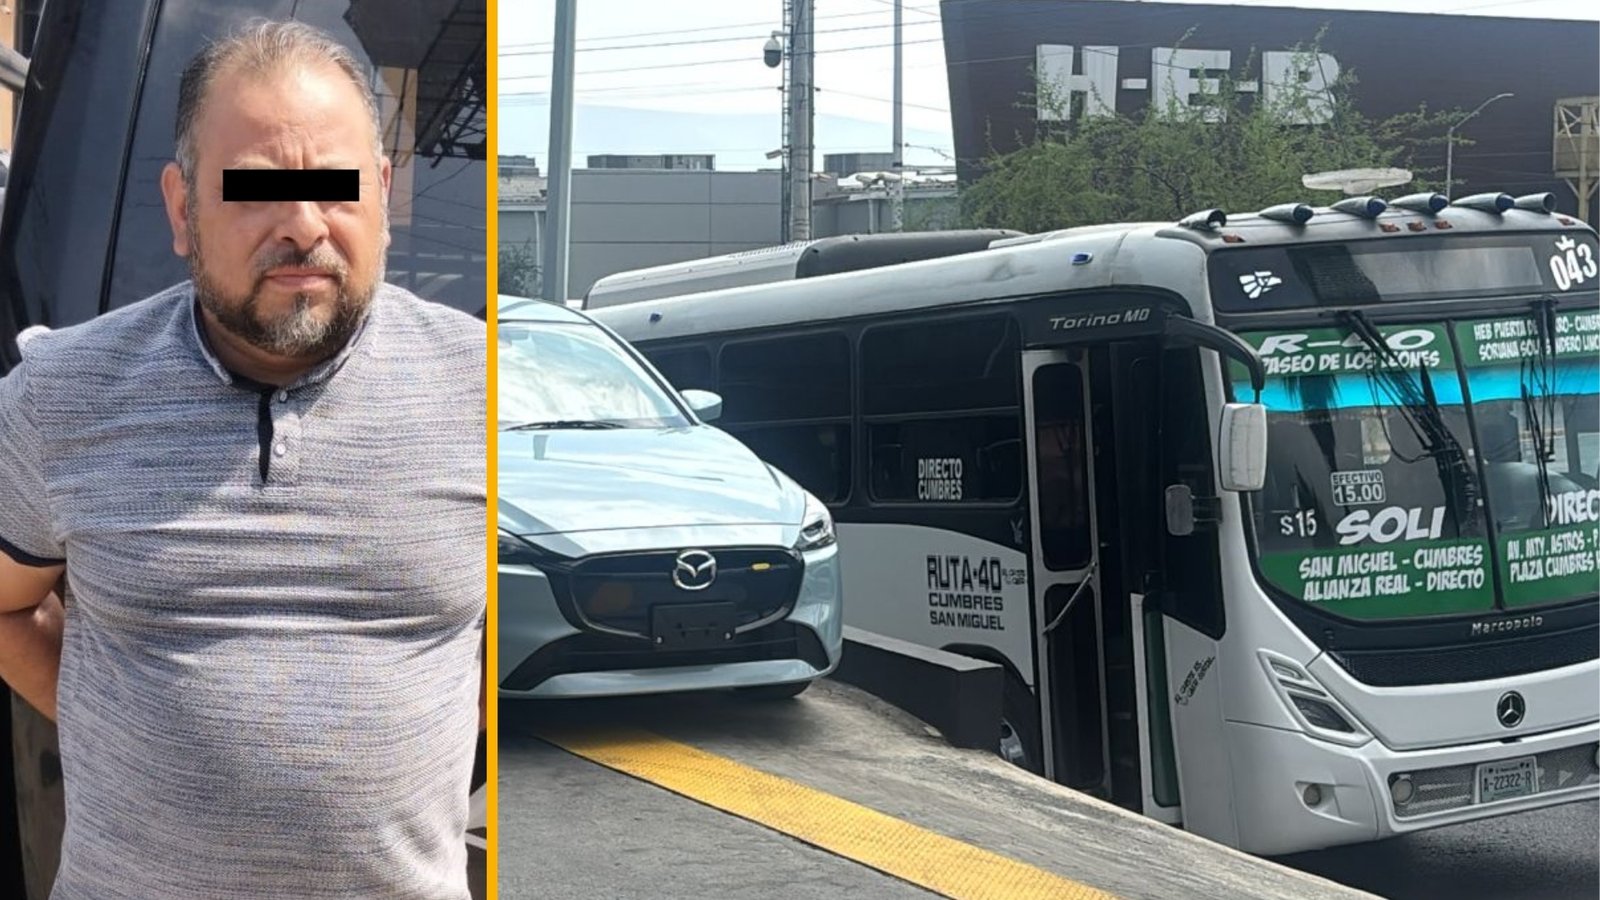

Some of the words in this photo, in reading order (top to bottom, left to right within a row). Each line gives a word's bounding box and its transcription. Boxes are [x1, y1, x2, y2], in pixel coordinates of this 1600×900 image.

[1036, 44, 1340, 125] H-E-B
[1549, 243, 1597, 291] 043
[1049, 313, 1121, 330] Torino
[1474, 323, 1492, 341] HEB
[1494, 320, 1526, 339] PUERTA
[1479, 341, 1520, 361] SORIANA
[1262, 354, 1315, 375] PASEO
[1319, 354, 1340, 370] DE
[1344, 352, 1377, 370] LOS
[918, 458, 963, 479] DIRECTO
[1332, 473, 1383, 485] EFECTIVO
[918, 480, 963, 500] CUMBRES
[1334, 484, 1383, 503] 15.00
[1335, 506, 1446, 545] SOLI
[1551, 530, 1585, 555] ASTROS
[1299, 556, 1333, 579] SAN
[1337, 551, 1398, 576] MIGUEL
[1414, 545, 1483, 570] CUMBRES
[1510, 558, 1544, 584] PLAZA
[1545, 551, 1594, 577] CUMBRES
[1303, 577, 1371, 601] ALIANZA
[1375, 574, 1411, 596] REAL
[1427, 568, 1485, 592] DIRECTO
[929, 592, 1003, 611] CUMBRES
[930, 610, 956, 628] SAN
[958, 612, 1005, 631] MIGUEL
[1471, 615, 1543, 636] Marcopolo
